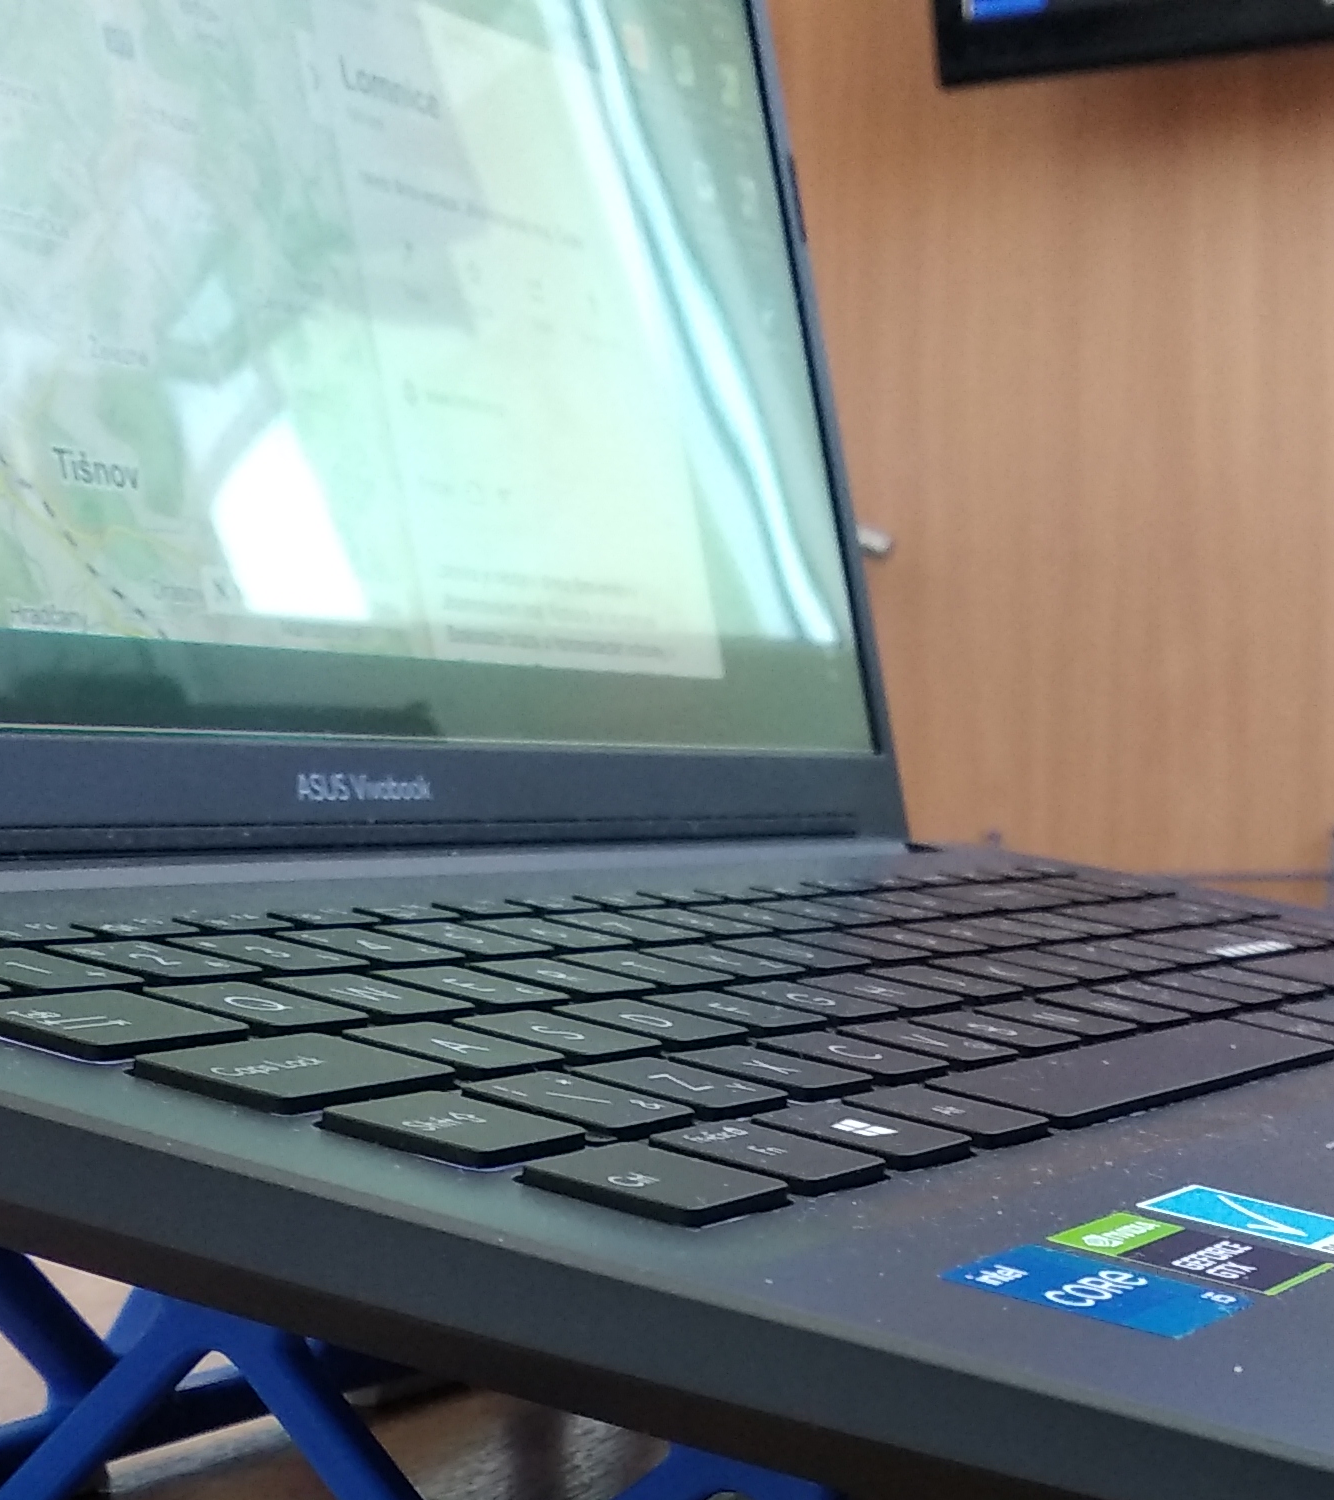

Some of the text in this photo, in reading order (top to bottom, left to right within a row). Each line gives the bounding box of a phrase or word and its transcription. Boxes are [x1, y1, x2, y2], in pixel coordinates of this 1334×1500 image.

[51, 447, 139, 490] Tišnov
[297, 773, 349, 800] ASUS
[128, 952, 183, 967] 2
[329, 986, 403, 1001] W
[784, 992, 837, 1008] G
[223, 996, 293, 1012] Q
[6, 1009, 62, 1020] Tab
[618, 1013, 674, 1029] D
[530, 1024, 586, 1042] S
[429, 1037, 491, 1054] A
[827, 1044, 884, 1061] C
[209, 1053, 329, 1079] Caps Lock
[741, 1058, 803, 1076] X
[647, 1072, 715, 1093] Z
[606, 1171, 661, 1189] Ctrl
[1170, 1239, 1255, 1272] GEFORCE
[964, 1264, 1030, 1287] intel
[1205, 1260, 1259, 1280] GTX
